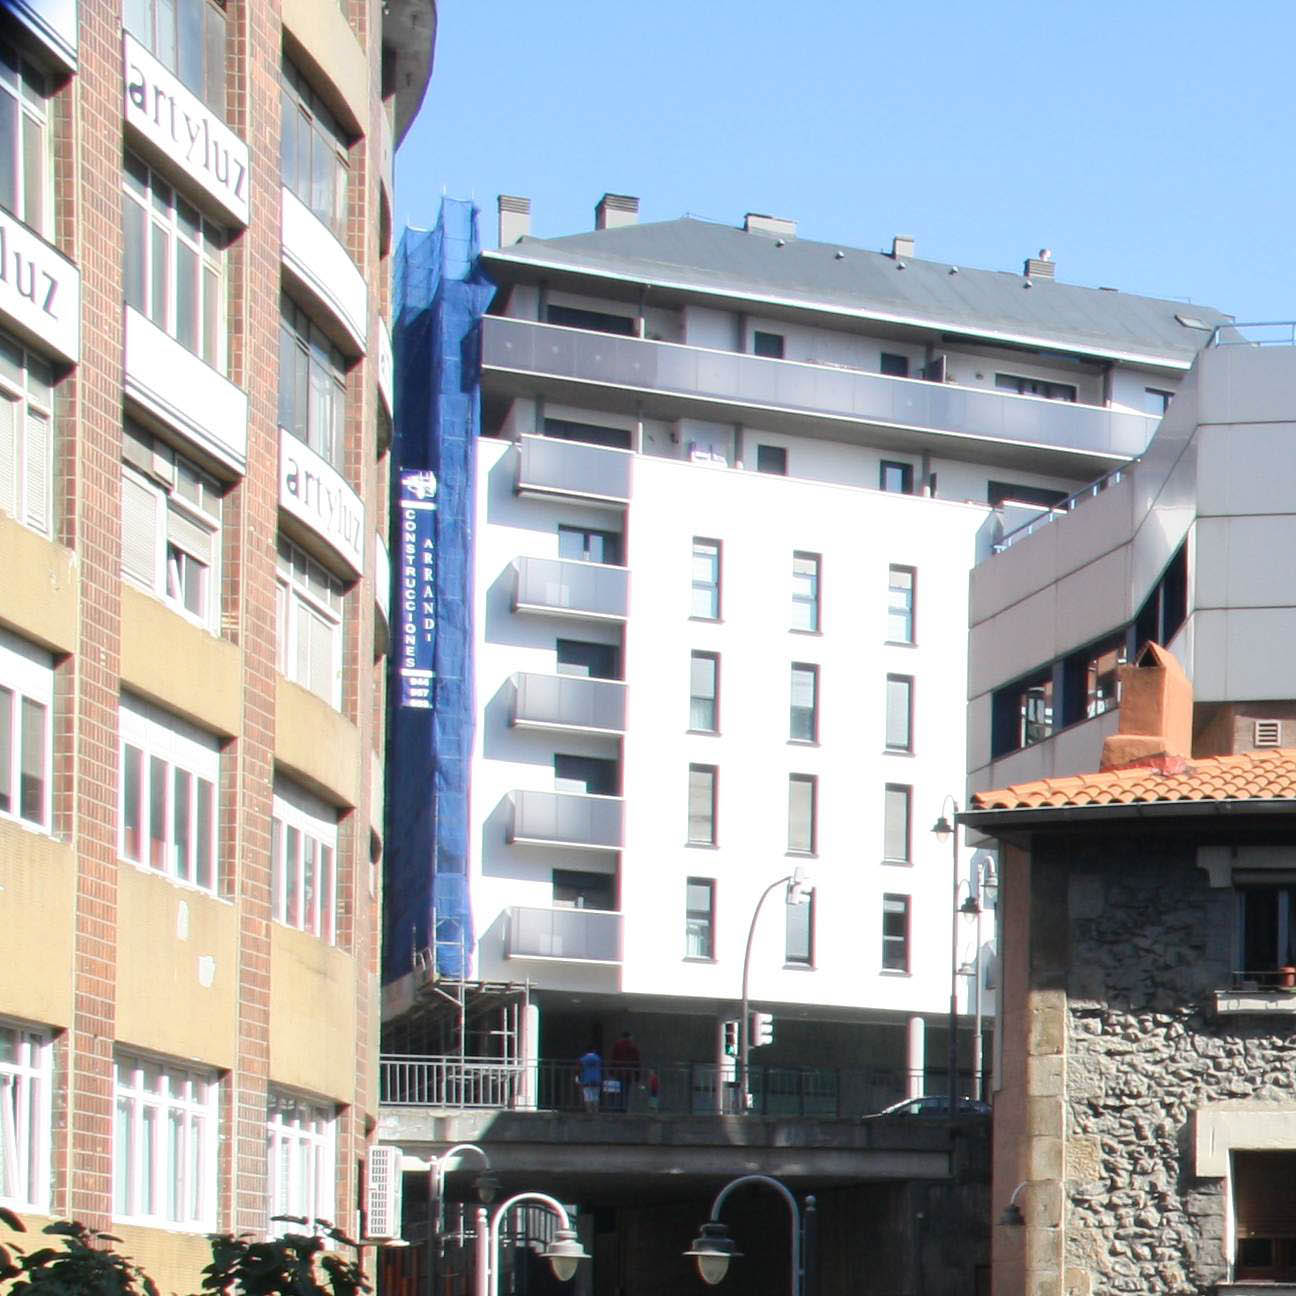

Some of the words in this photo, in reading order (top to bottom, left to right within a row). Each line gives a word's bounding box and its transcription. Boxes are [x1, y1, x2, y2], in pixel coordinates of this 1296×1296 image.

[129, 64, 246, 204] artyluz
[287, 457, 361, 554] artyluz
[404, 509, 417, 668] CONSTRUCCIONES
[423, 538, 435, 642] ARRANDI
